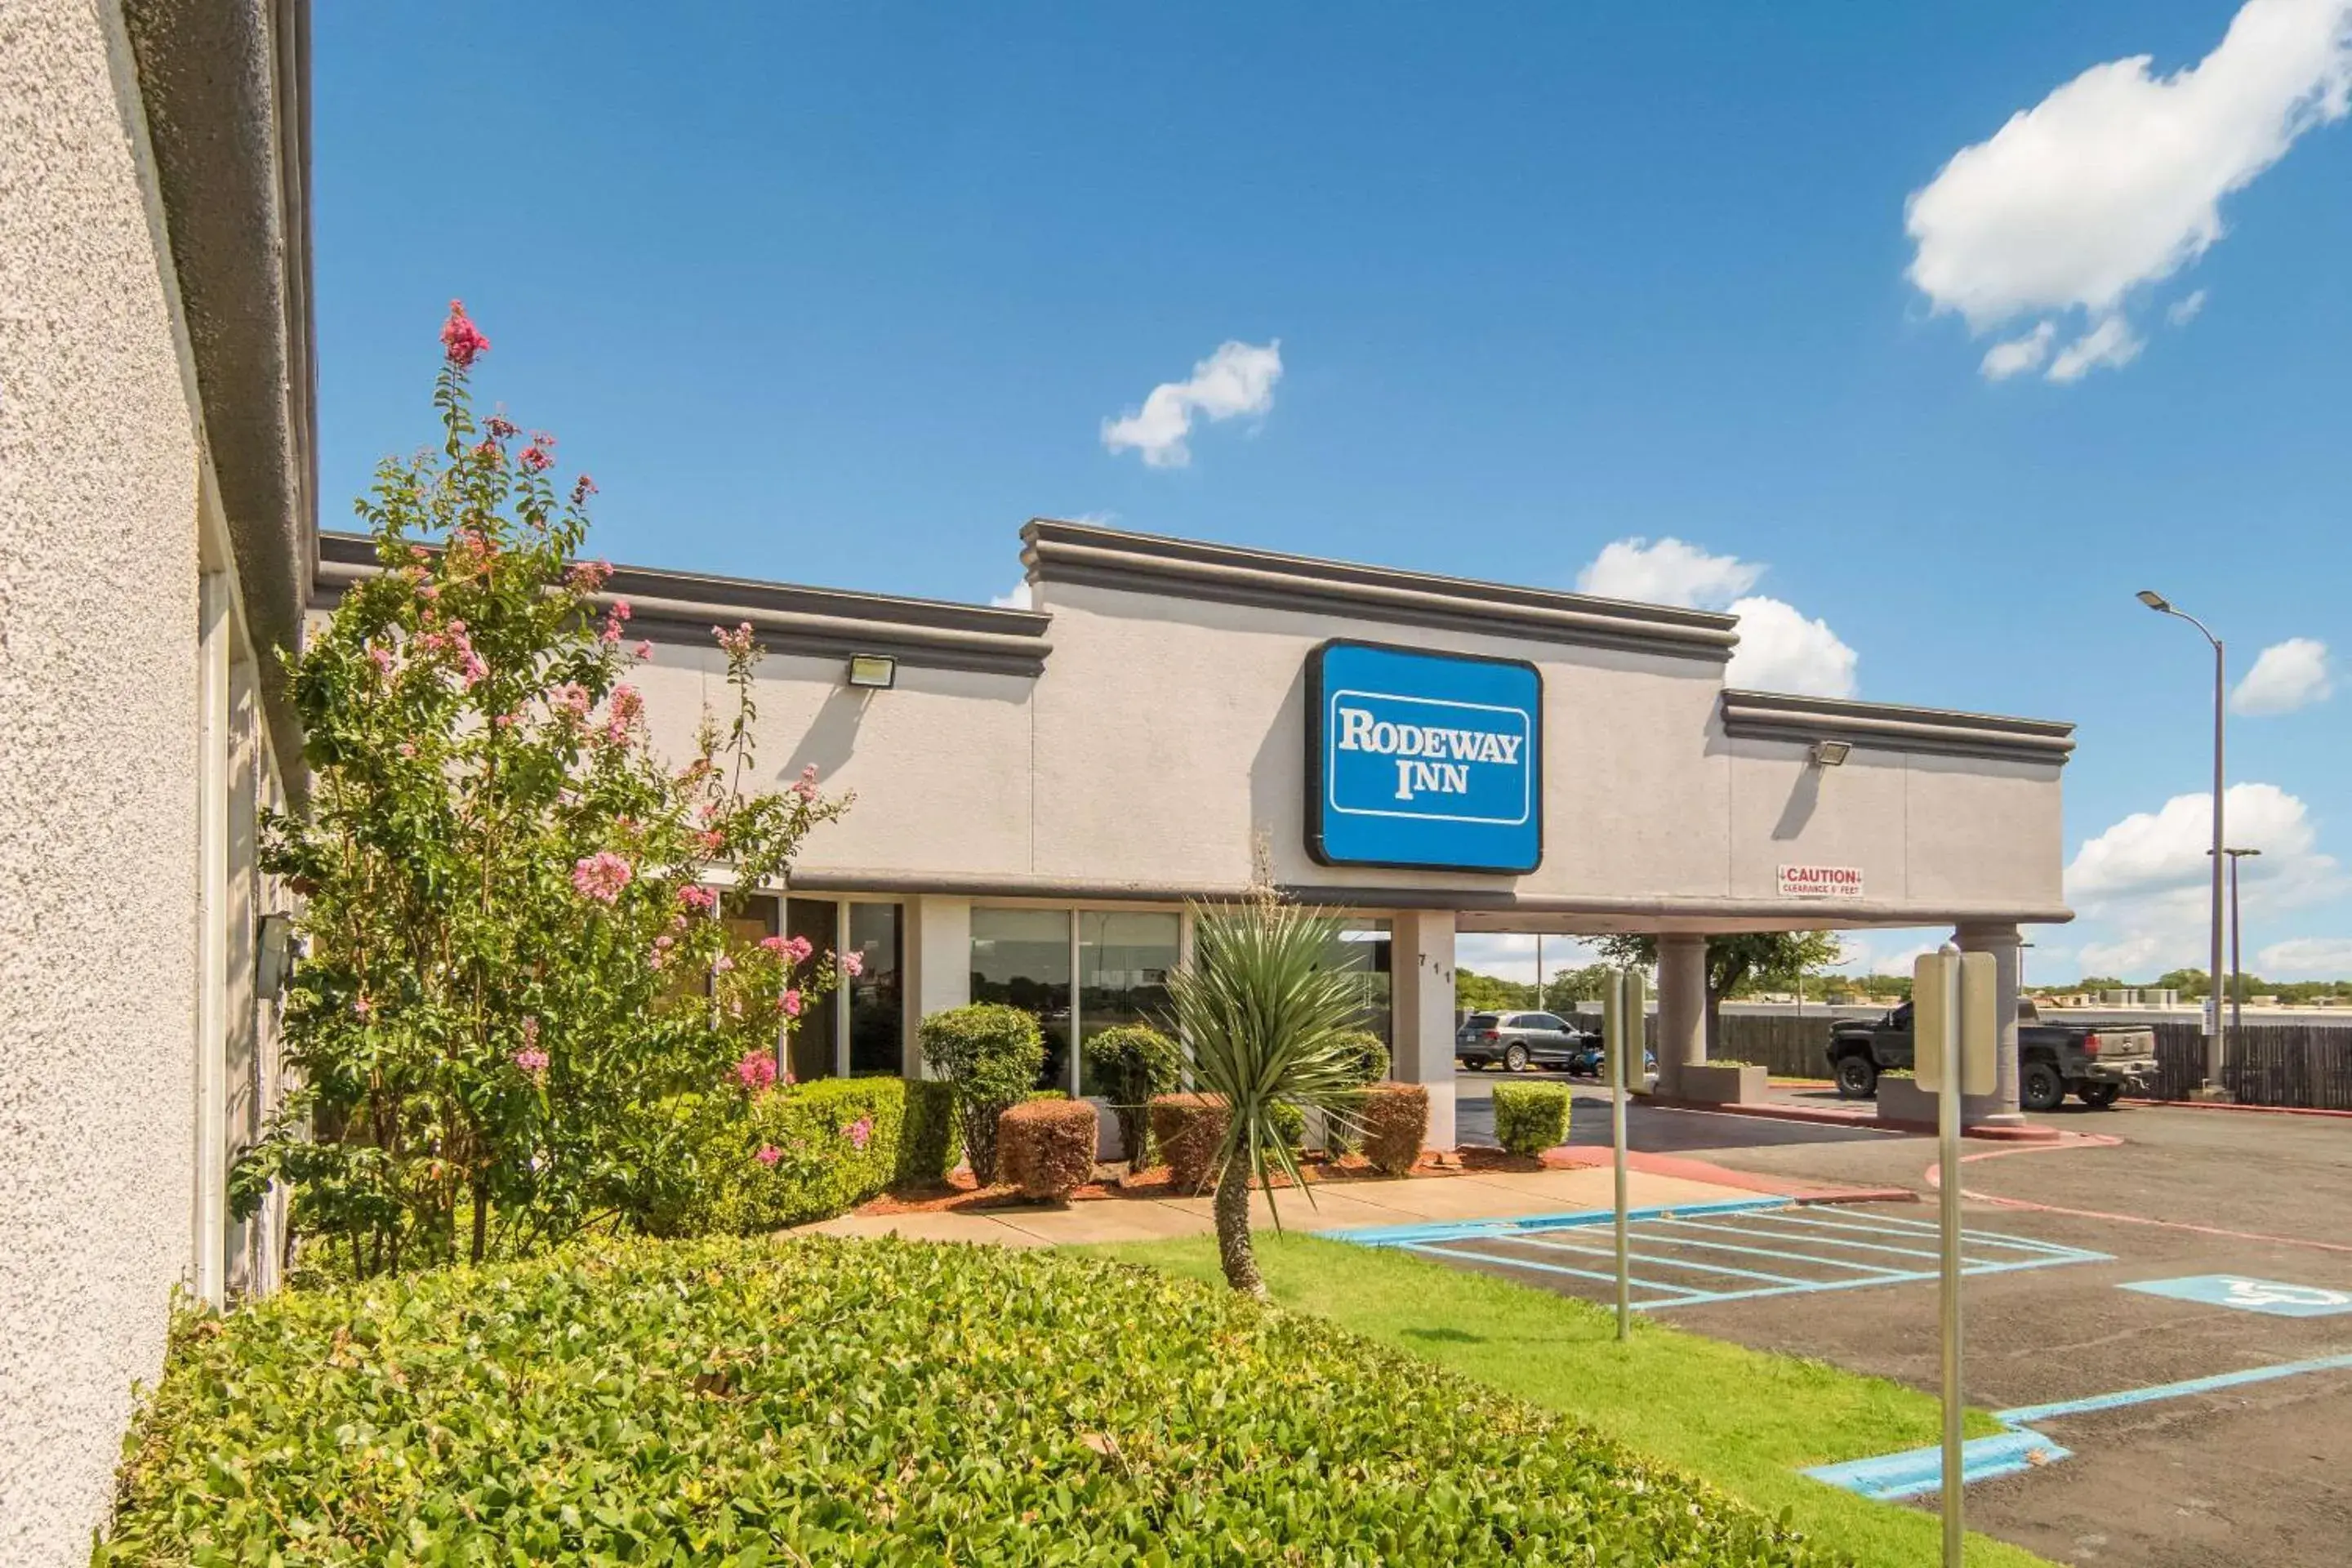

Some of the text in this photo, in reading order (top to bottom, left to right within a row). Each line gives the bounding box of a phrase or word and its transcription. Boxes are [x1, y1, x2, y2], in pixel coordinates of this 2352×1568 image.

[1339, 706, 1523, 764] RODEWAY
[1395, 759, 1470, 800] INN
[1783, 884, 1829, 893] CLEARANCE
[1787, 868, 1856, 884] CAUTION
